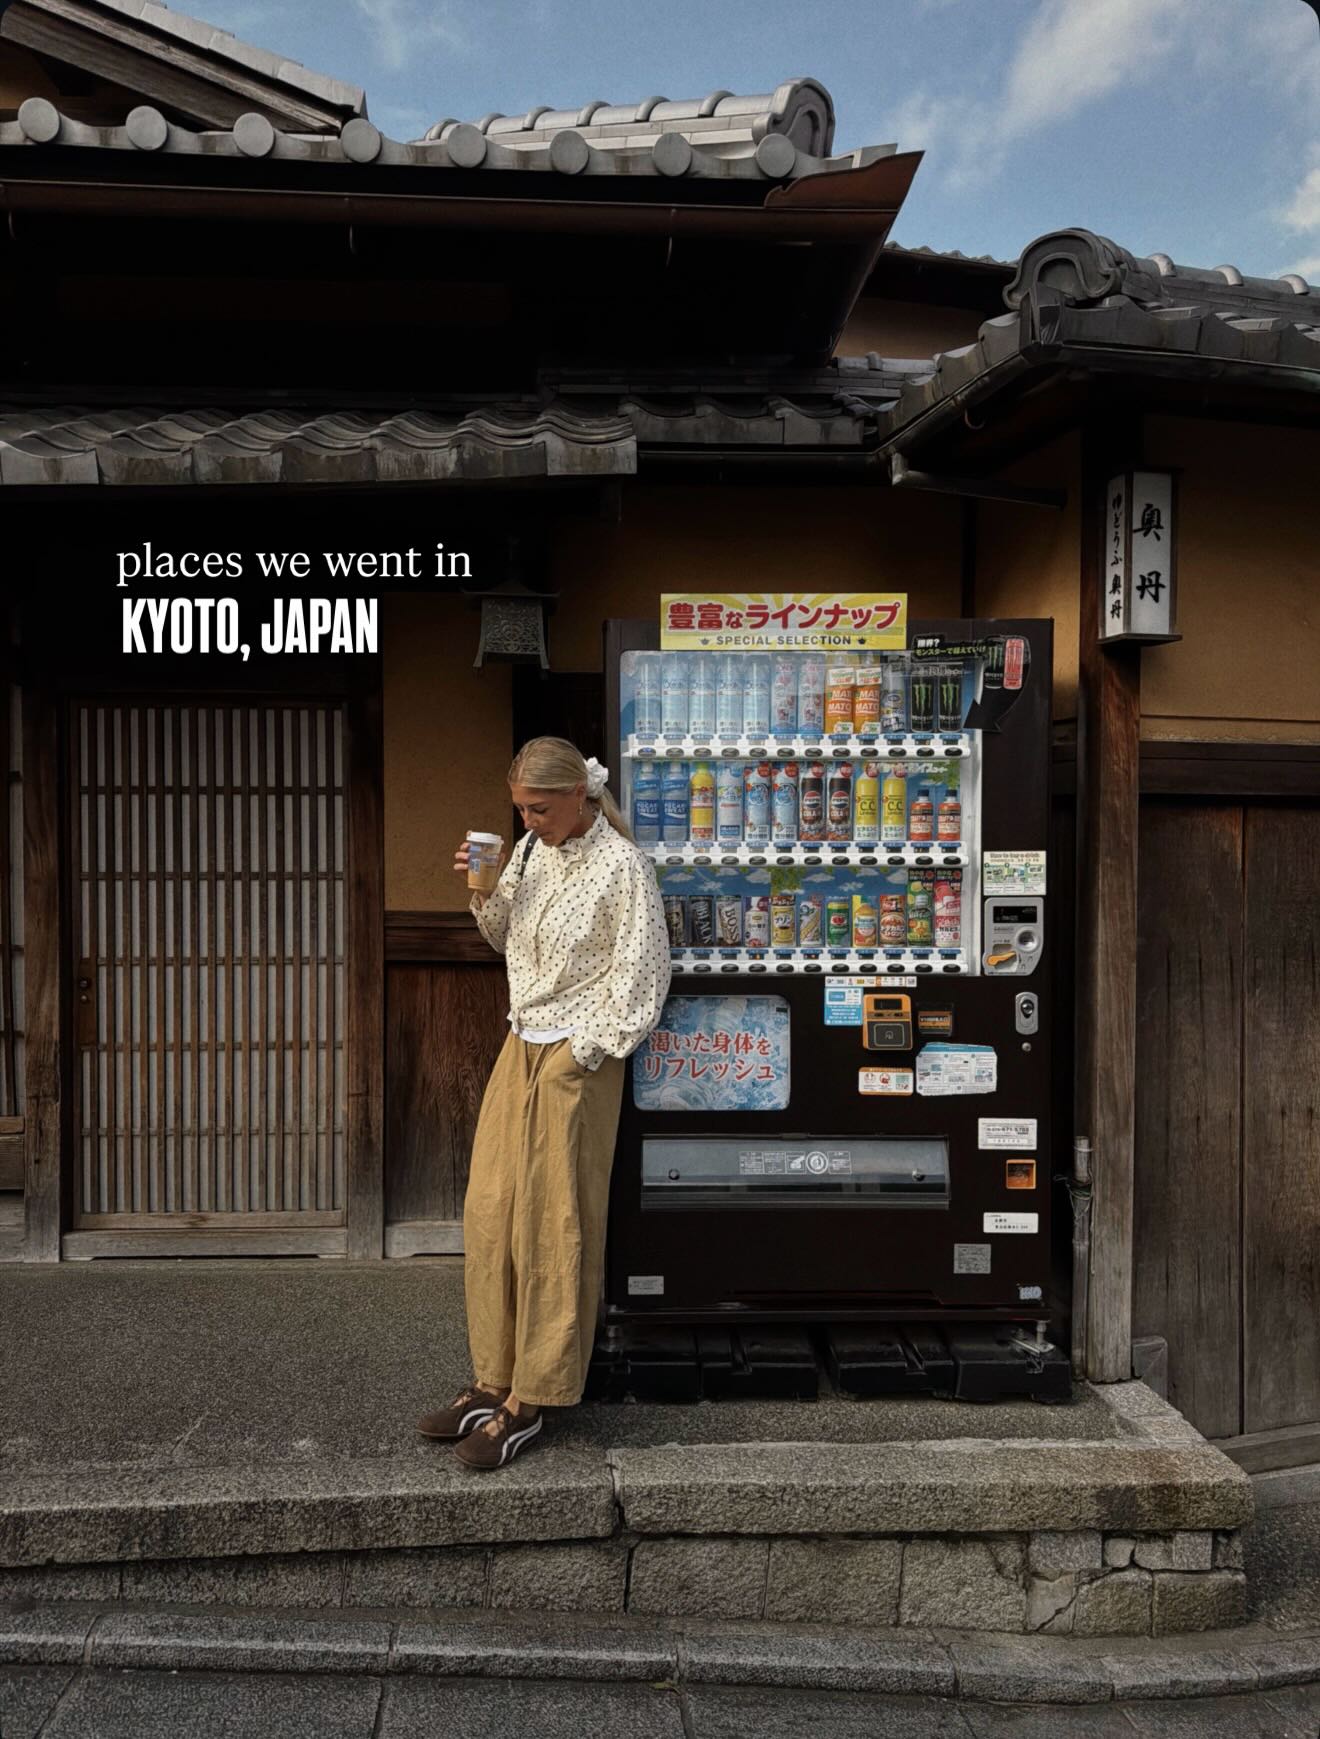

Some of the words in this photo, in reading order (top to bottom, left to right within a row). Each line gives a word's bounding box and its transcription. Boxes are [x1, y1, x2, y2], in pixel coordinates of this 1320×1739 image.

[1133, 503, 1166, 603] 奥丹
[668, 602, 901, 631] 豊富なラインナップ
[716, 635, 772, 646] SPECIAL
[777, 635, 851, 646] SELECTION
[725, 908, 740, 942] BOSS
[650, 1031, 771, 1056] 渇いた身体を
[644, 1057, 775, 1081] リフレッシュ
